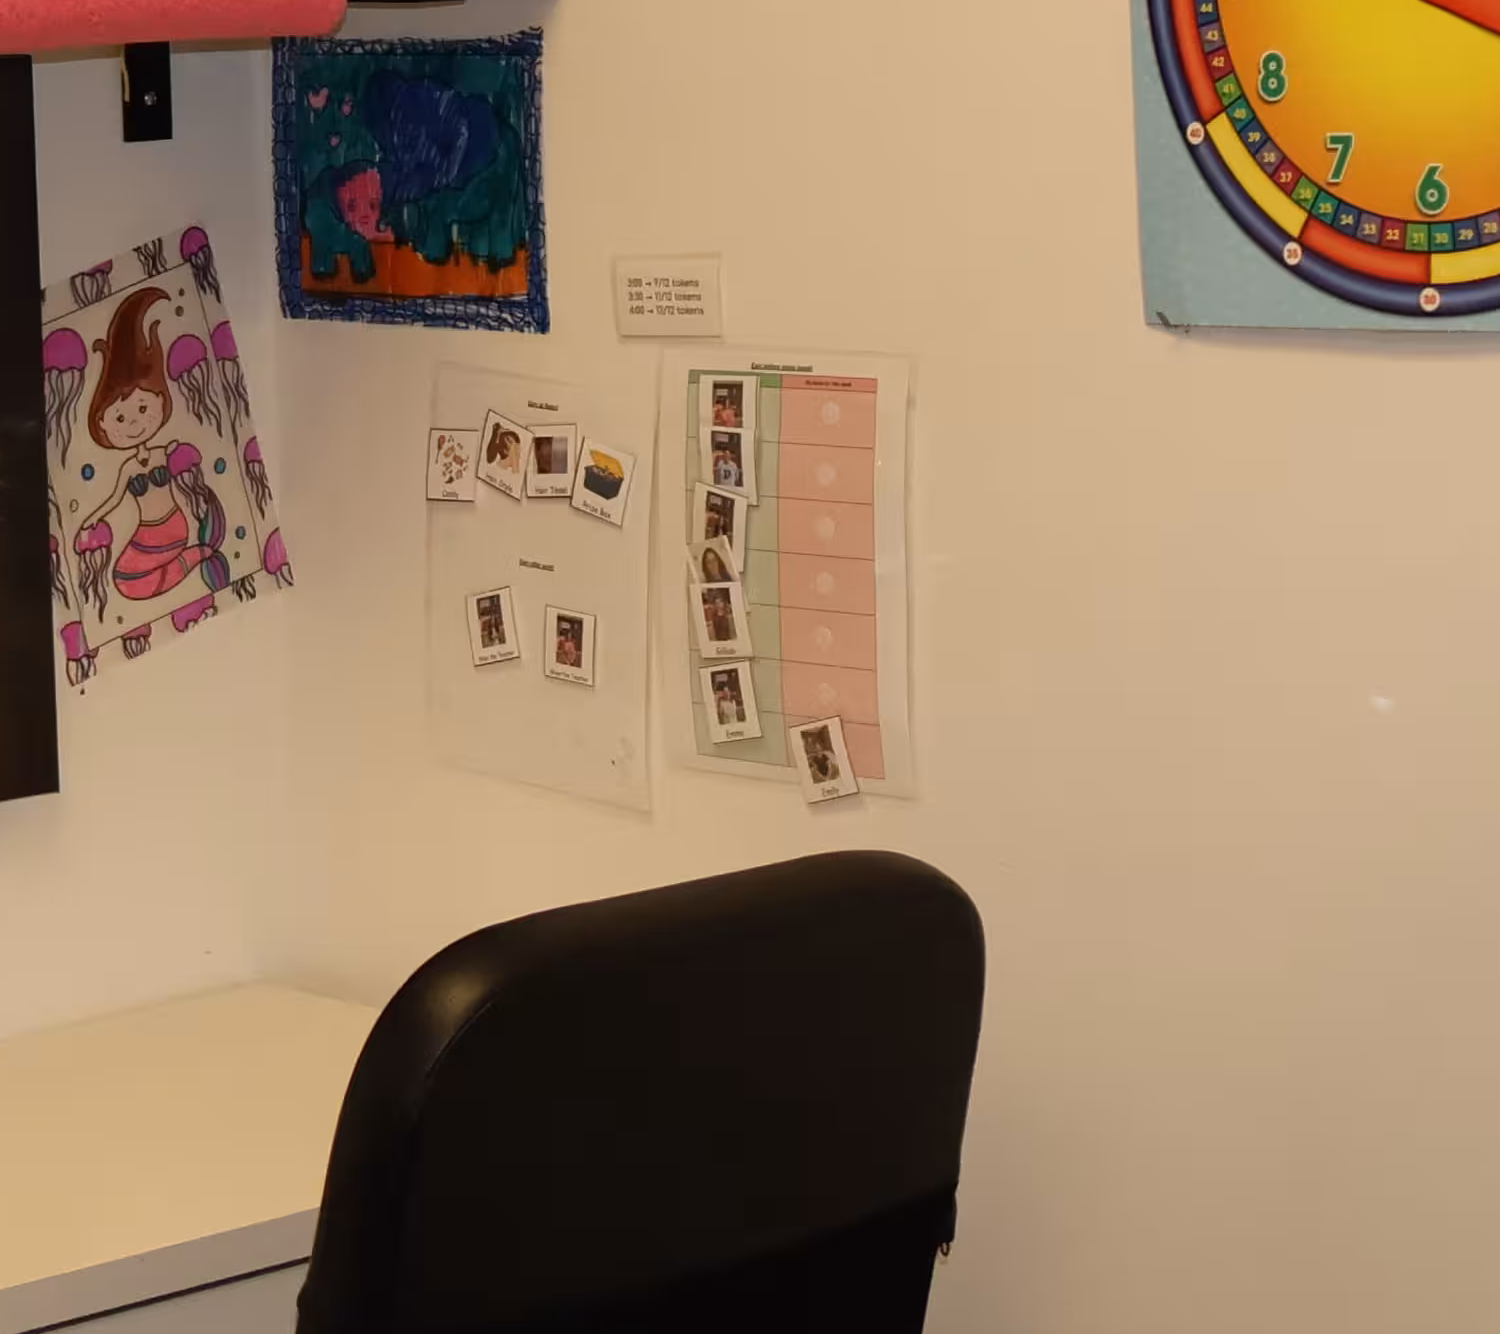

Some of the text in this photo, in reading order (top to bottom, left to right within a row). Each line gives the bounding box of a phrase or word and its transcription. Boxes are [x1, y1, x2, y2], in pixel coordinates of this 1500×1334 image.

[1258, 50, 1288, 102] 8
[1325, 132, 1355, 184] 7
[1414, 162, 1451, 216] 6
